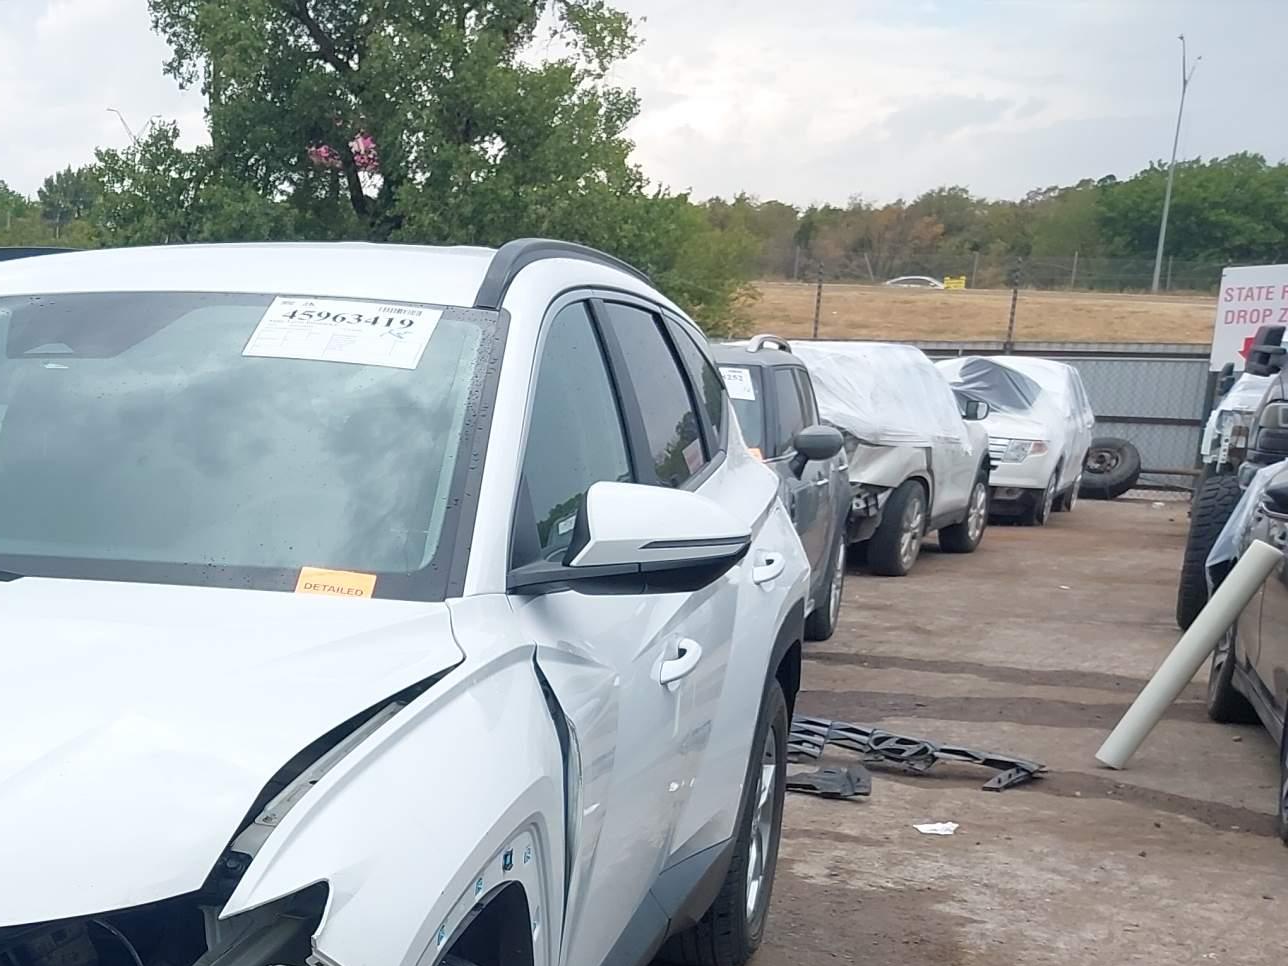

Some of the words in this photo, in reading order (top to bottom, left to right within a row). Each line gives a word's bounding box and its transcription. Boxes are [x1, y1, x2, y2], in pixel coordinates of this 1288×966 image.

[1224, 285, 1275, 302] STATE
[282, 309, 414, 329] 45963419
[1224, 308, 1273, 325] DROP
[304, 582, 364, 597] DETAILED
